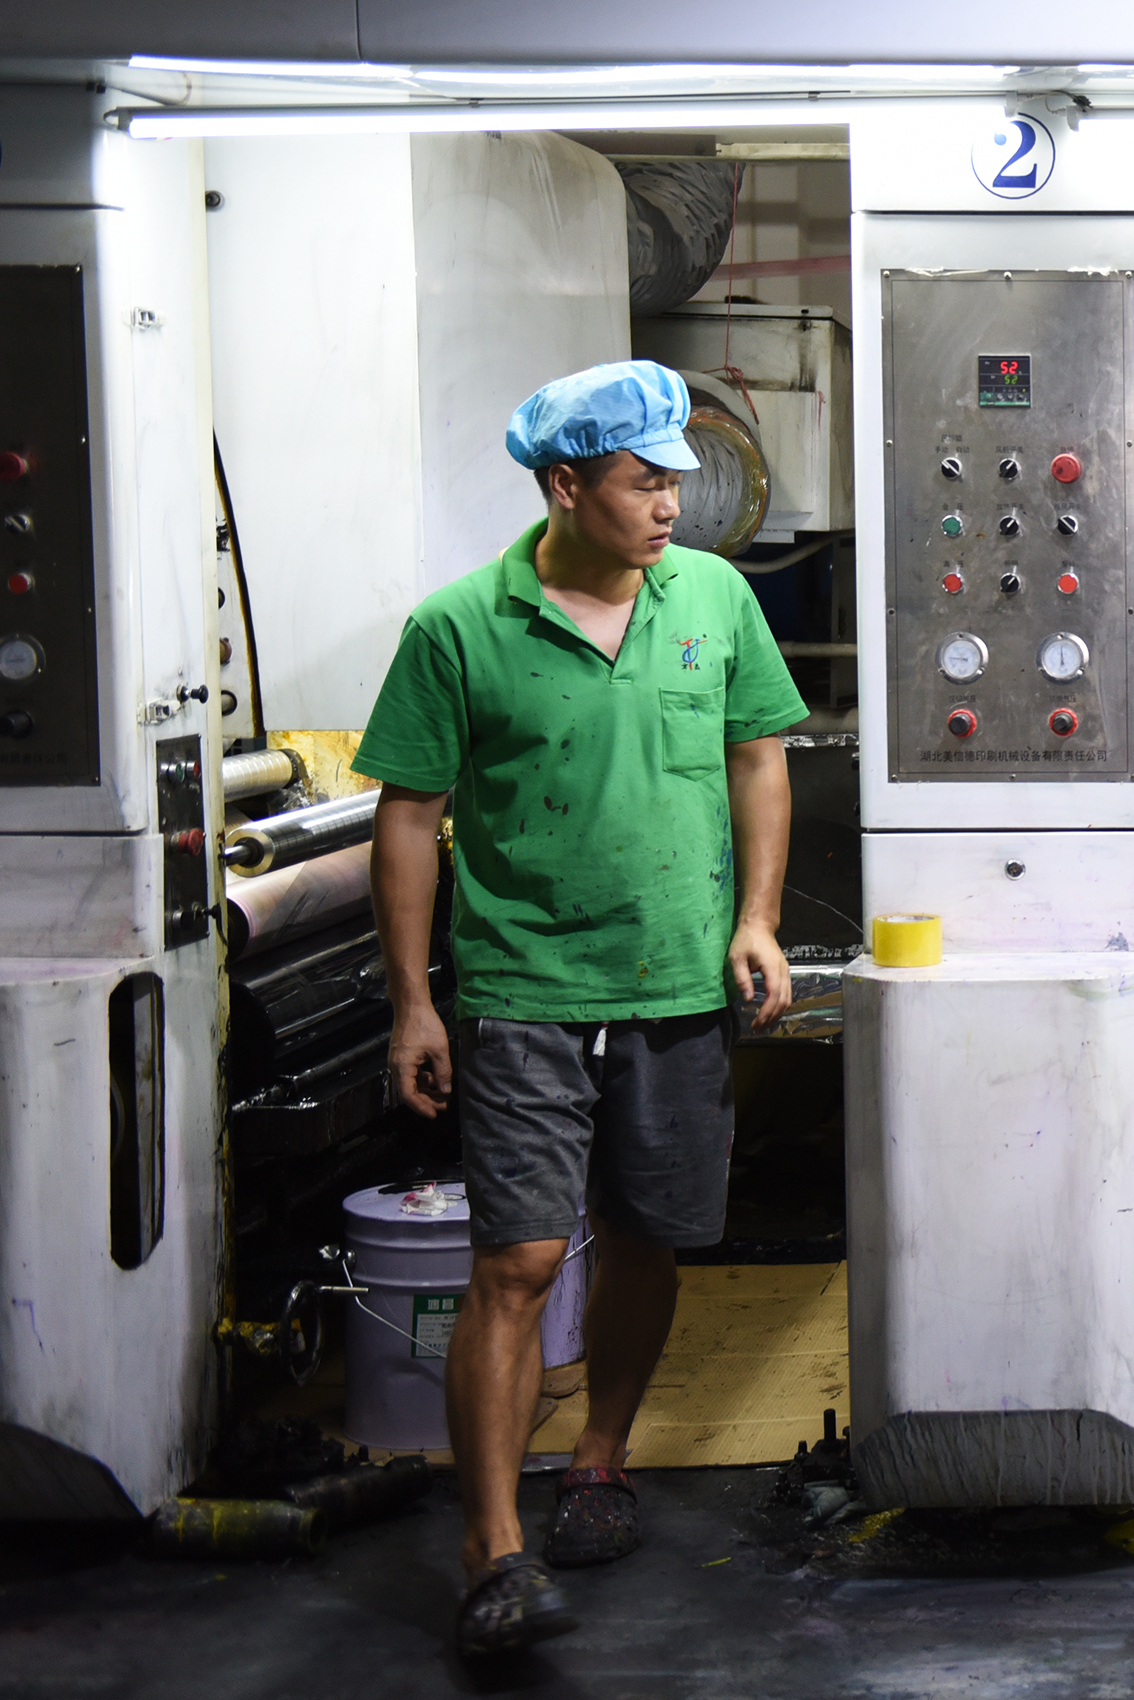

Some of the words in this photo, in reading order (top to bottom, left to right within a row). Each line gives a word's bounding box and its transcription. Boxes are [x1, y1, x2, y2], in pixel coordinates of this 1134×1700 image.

[992, 120, 1038, 189] 2
[1000, 361, 1019, 375] 52
[1004, 375, 1019, 385] 52
[920, 750, 1108, 763] 湖北美信德印刷机械设备有限责任公司
